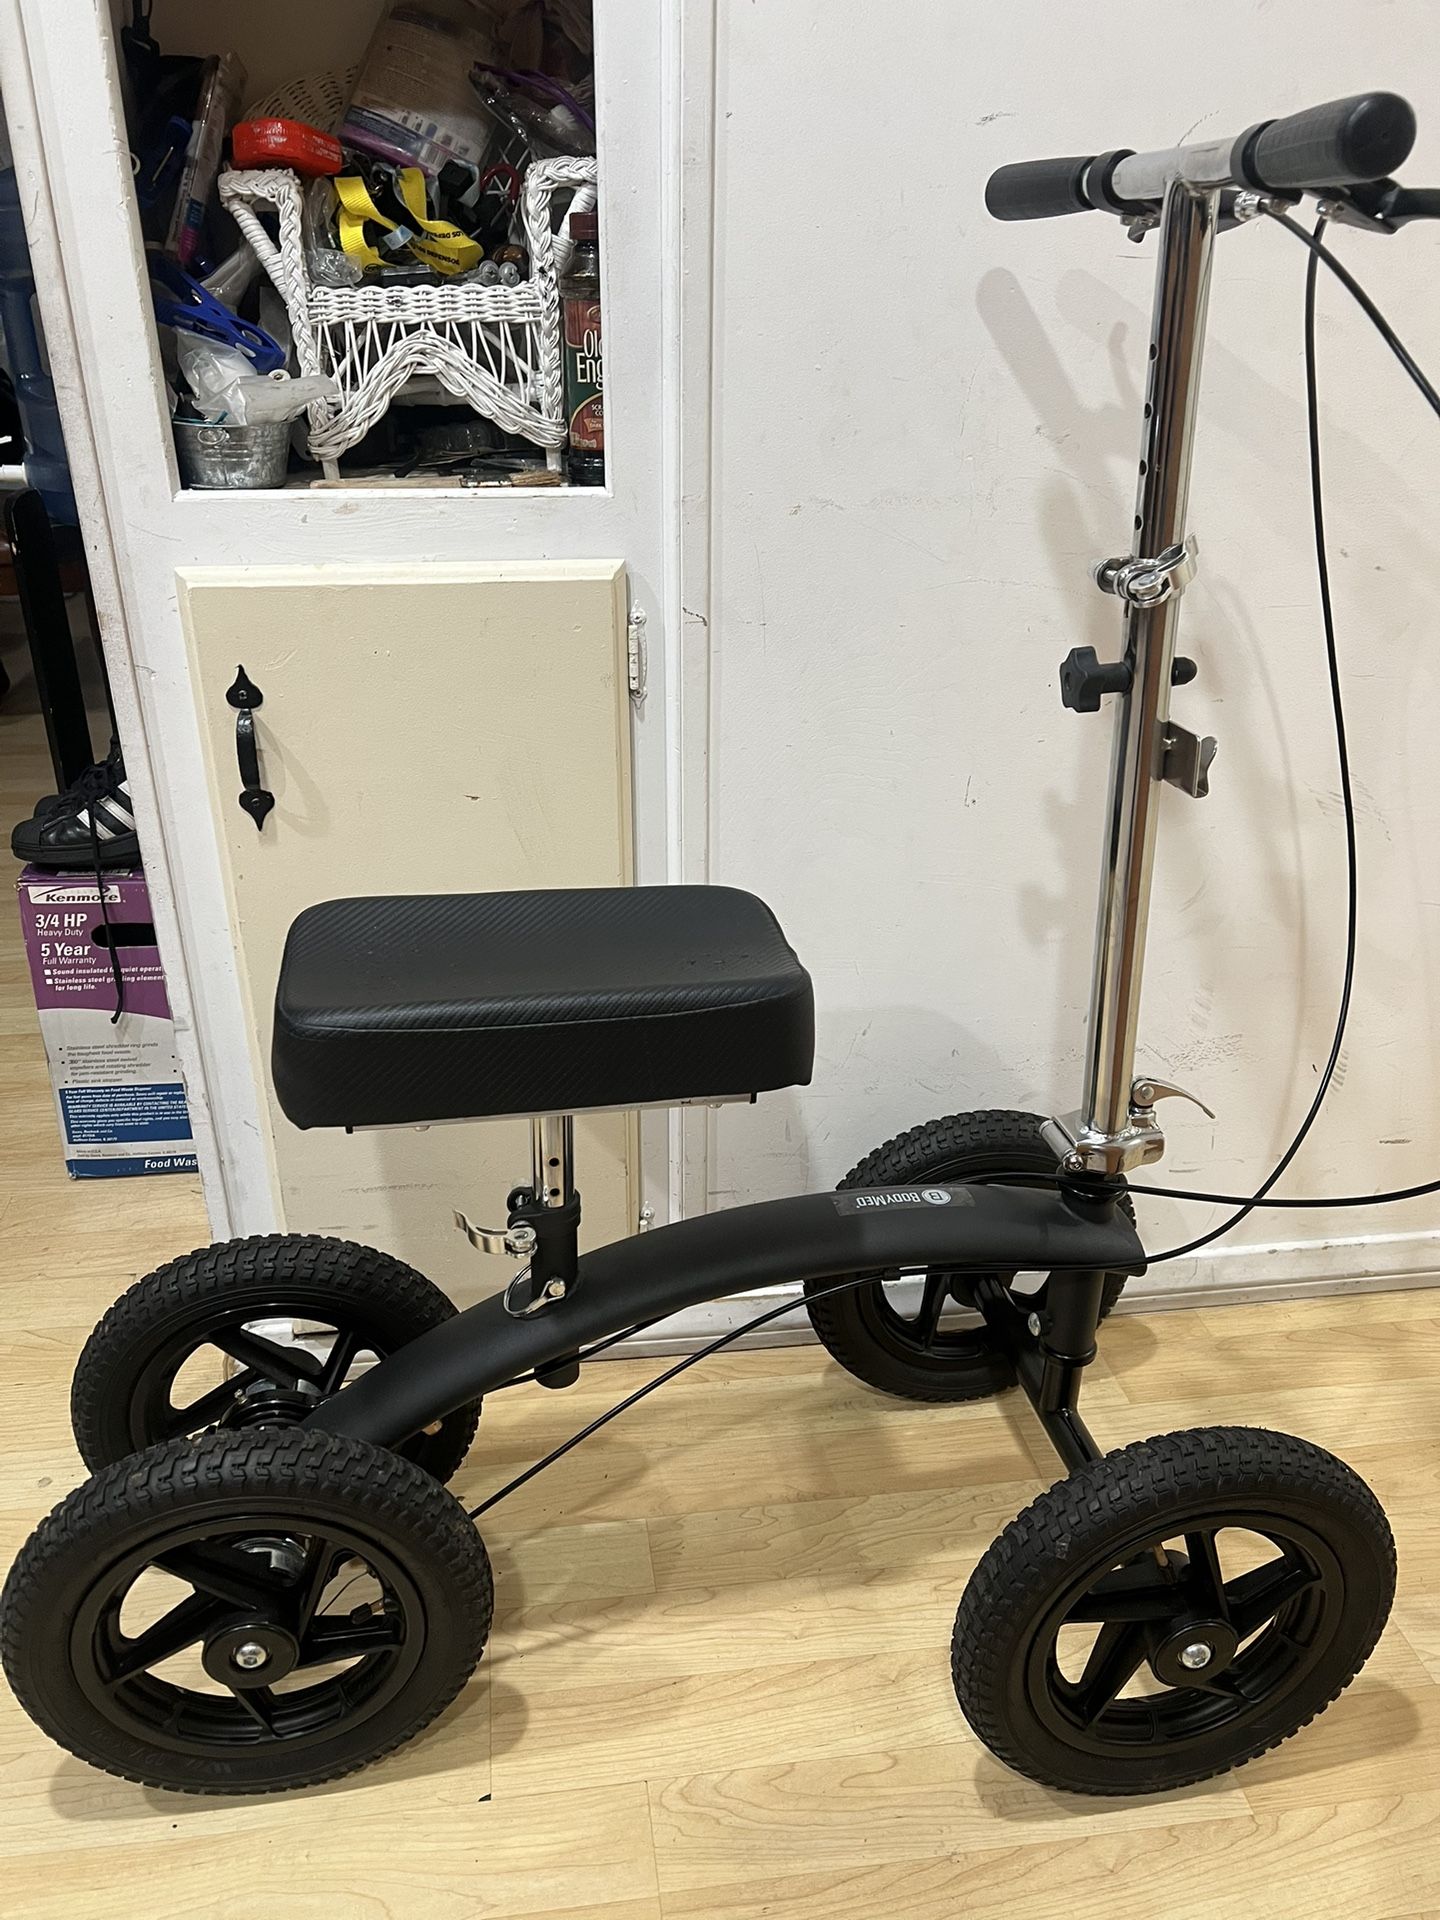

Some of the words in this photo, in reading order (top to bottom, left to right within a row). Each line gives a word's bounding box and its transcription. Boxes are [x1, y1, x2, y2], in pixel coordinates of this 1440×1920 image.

[35, 914, 60, 929] 3/4
[64, 913, 88, 927] HP
[37, 929, 63, 937] Heavy
[64, 928, 84, 937] Duty
[41, 943, 51, 957] 5
[54, 942, 91, 957] Year
[42, 957, 57, 965] Full
[58, 956, 97, 965] Warranty
[53, 968, 75, 976] Sound
[75, 966, 108, 974] insulated
[144, 1159, 170, 1169] Food
